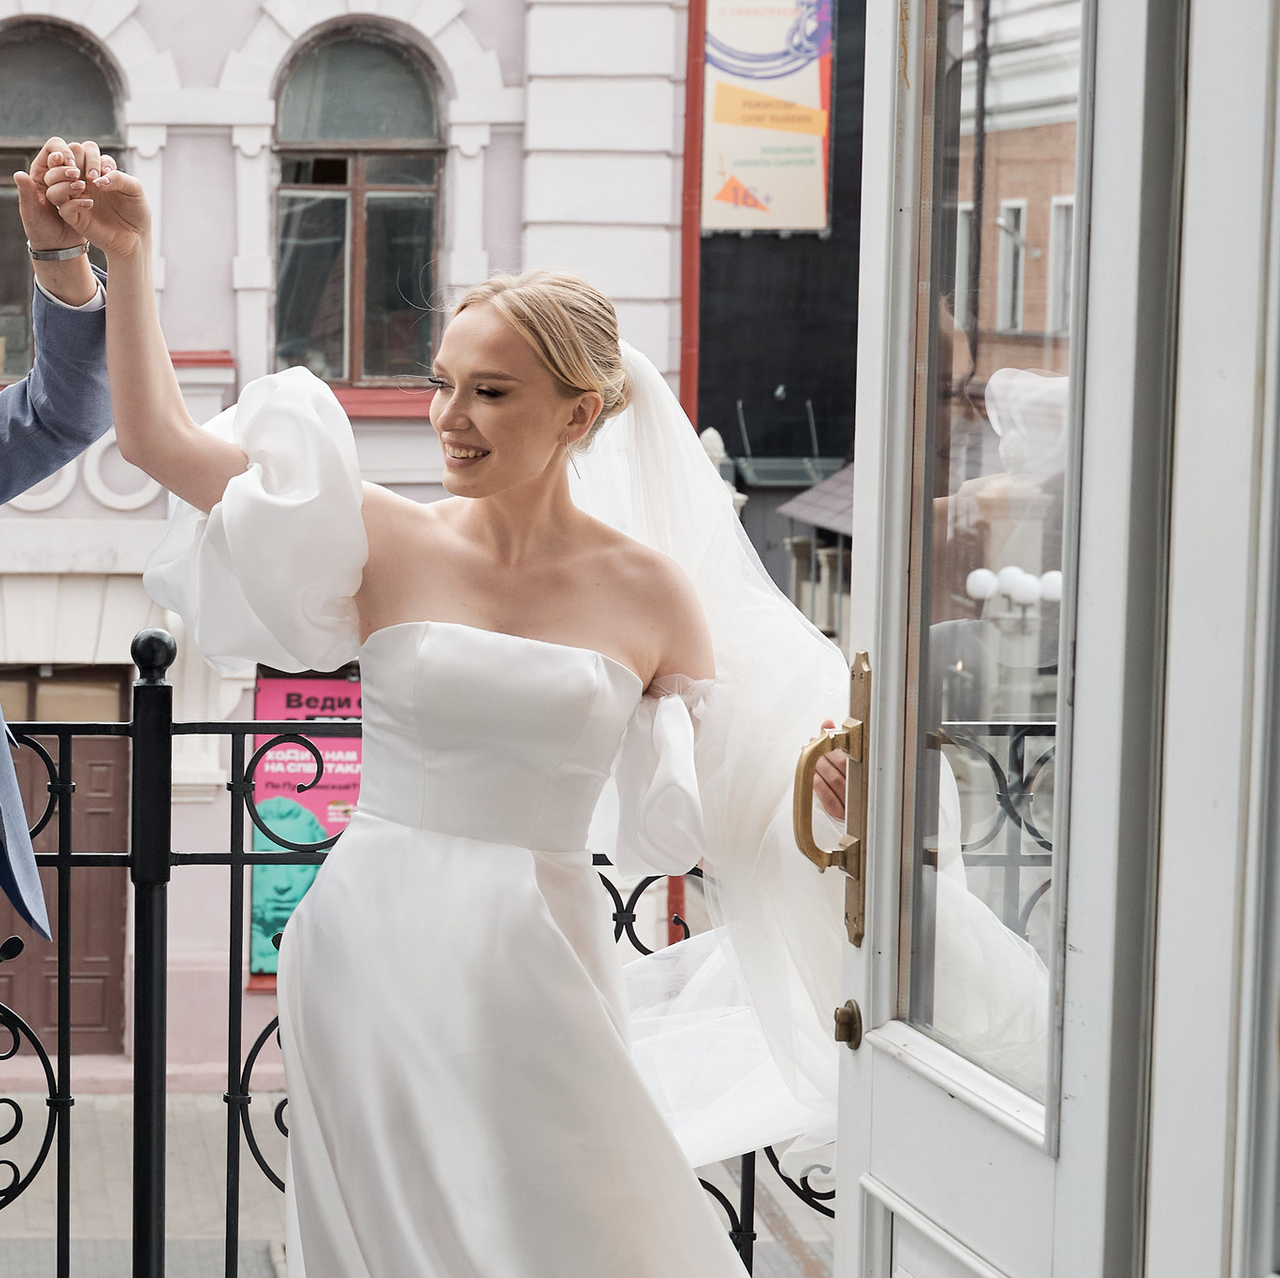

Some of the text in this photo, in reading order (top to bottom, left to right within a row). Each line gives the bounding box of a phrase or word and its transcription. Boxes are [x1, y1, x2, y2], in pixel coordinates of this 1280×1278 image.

[733, 185, 774, 209] 16+
[285, 692, 352, 712] Веди
[324, 750, 358, 761] НАМ
[264, 762, 285, 773] НА
